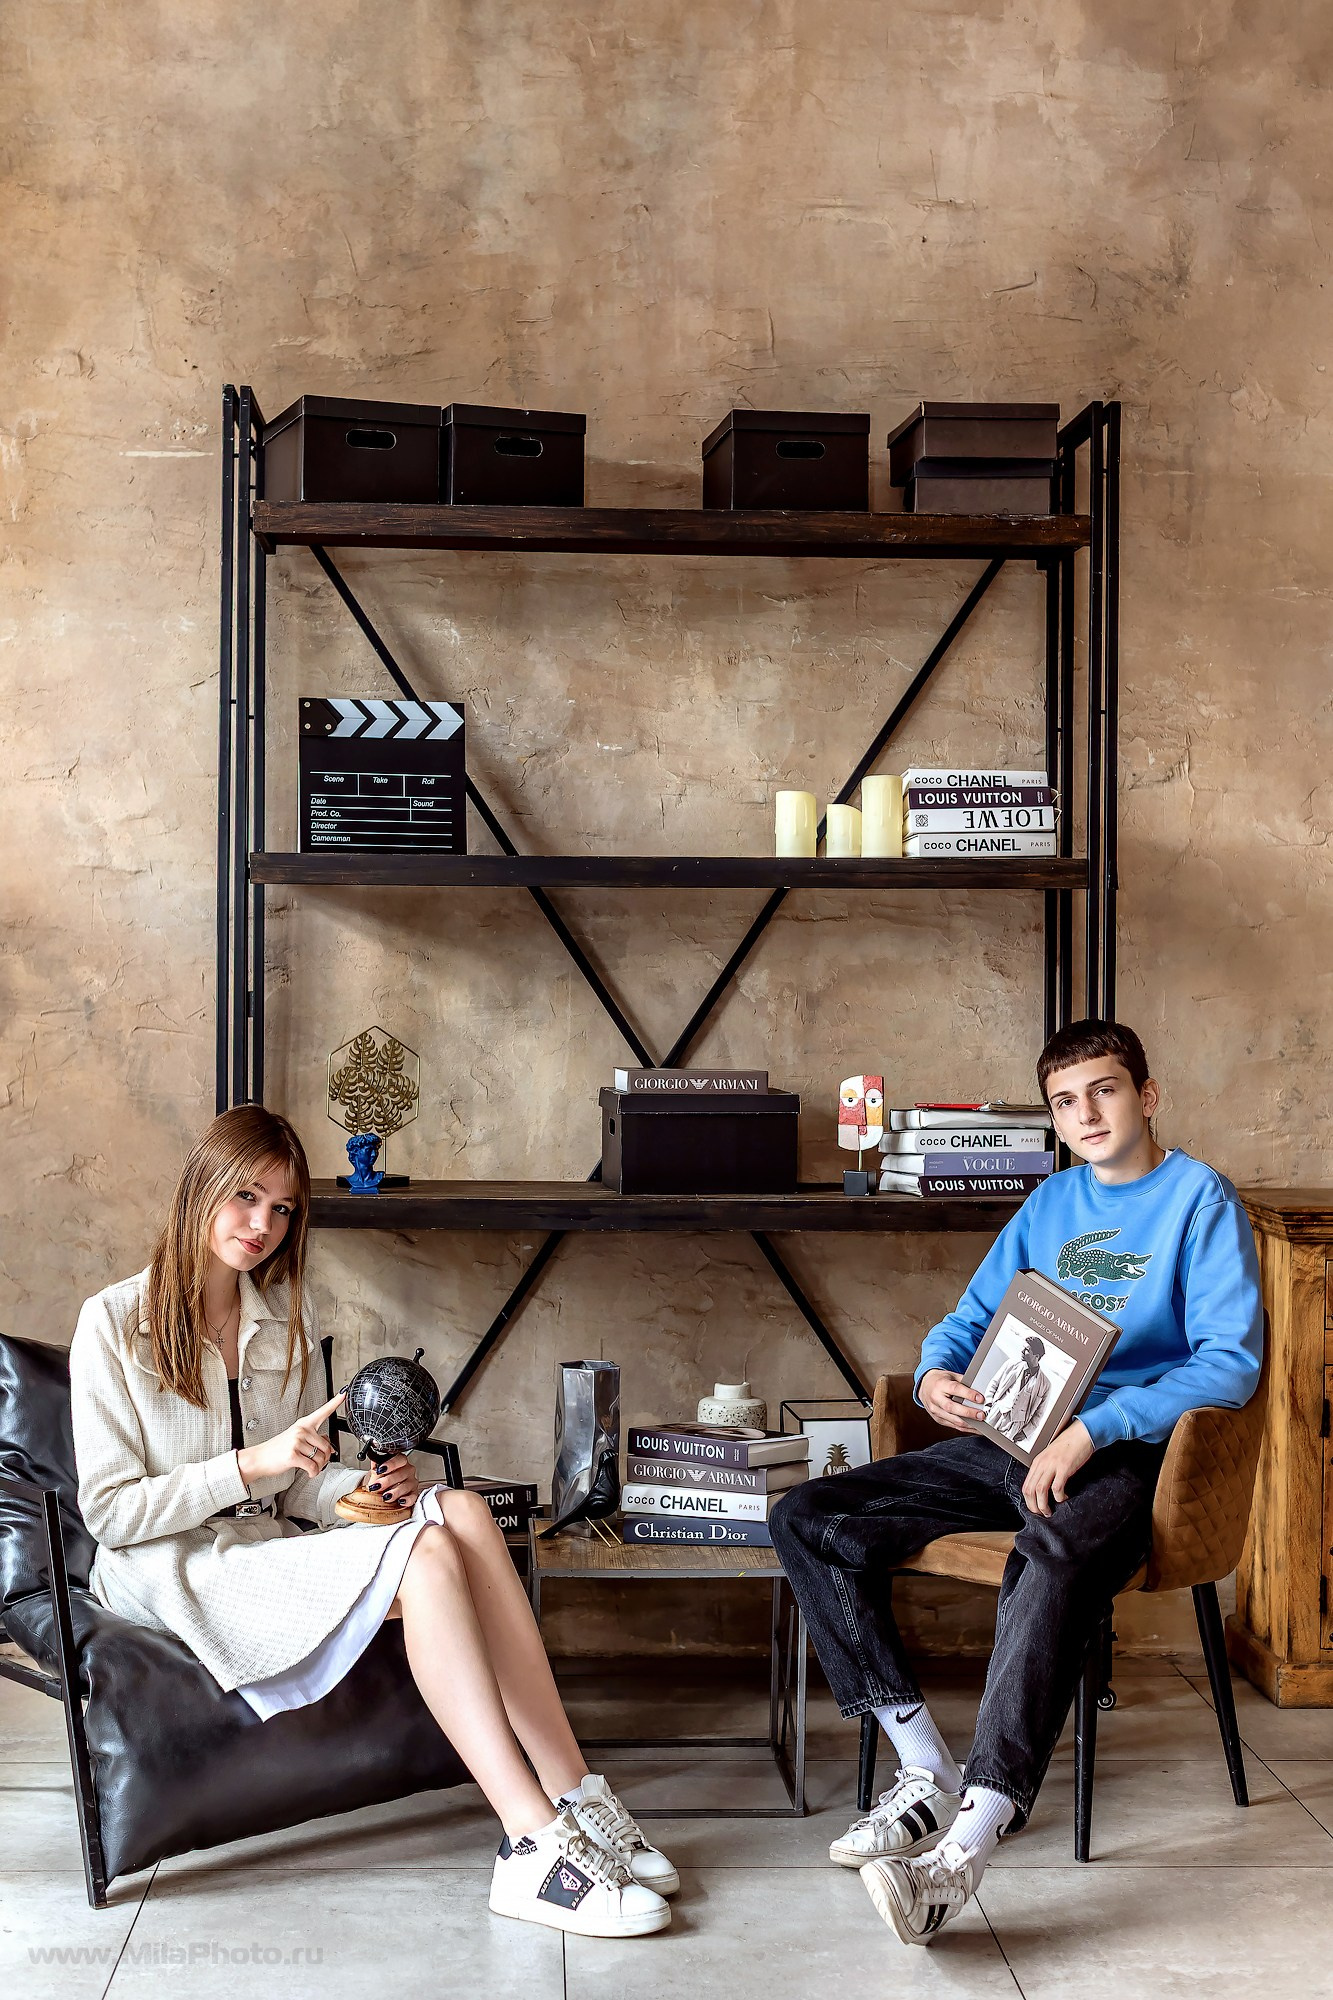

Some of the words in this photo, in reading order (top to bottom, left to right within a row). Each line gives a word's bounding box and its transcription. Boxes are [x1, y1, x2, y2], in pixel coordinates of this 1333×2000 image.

[323, 775, 345, 783] Scene
[421, 777, 435, 785] Roll
[946, 774, 1012, 787] CHANEL
[918, 793, 958, 804] LOUIS
[962, 792, 1022, 804] VUITTON
[962, 809, 1044, 828] LOEWE
[311, 834, 350, 842] Cameraman
[955, 838, 1021, 852] CHANEL
[634, 1078, 688, 1090] GIORGIO
[709, 1079, 759, 1090] ARMANI
[950, 1134, 1012, 1148] CHANEL
[963, 1157, 1016, 1171] VOGUE
[928, 1180, 966, 1191] LOUIS
[969, 1179, 1024, 1191] VUITTON
[1017, 1290, 1055, 1321] GIORGIO
[1053, 1316, 1090, 1346] ARMANI
[1029, 1316, 1046, 1331] IMAGES
[1052, 1332, 1065, 1344] MAN
[636, 1435, 670, 1452] LOUIS
[673, 1440, 724, 1460] VUITTON
[634, 1464, 686, 1481] GIORGIO
[706, 1472, 757, 1488] ARMANI
[484, 1492, 515, 1506] TTON
[659, 1494, 728, 1513] CHANEL
[634, 1522, 704, 1540] Christian
[708, 1524, 748, 1541] Dior
